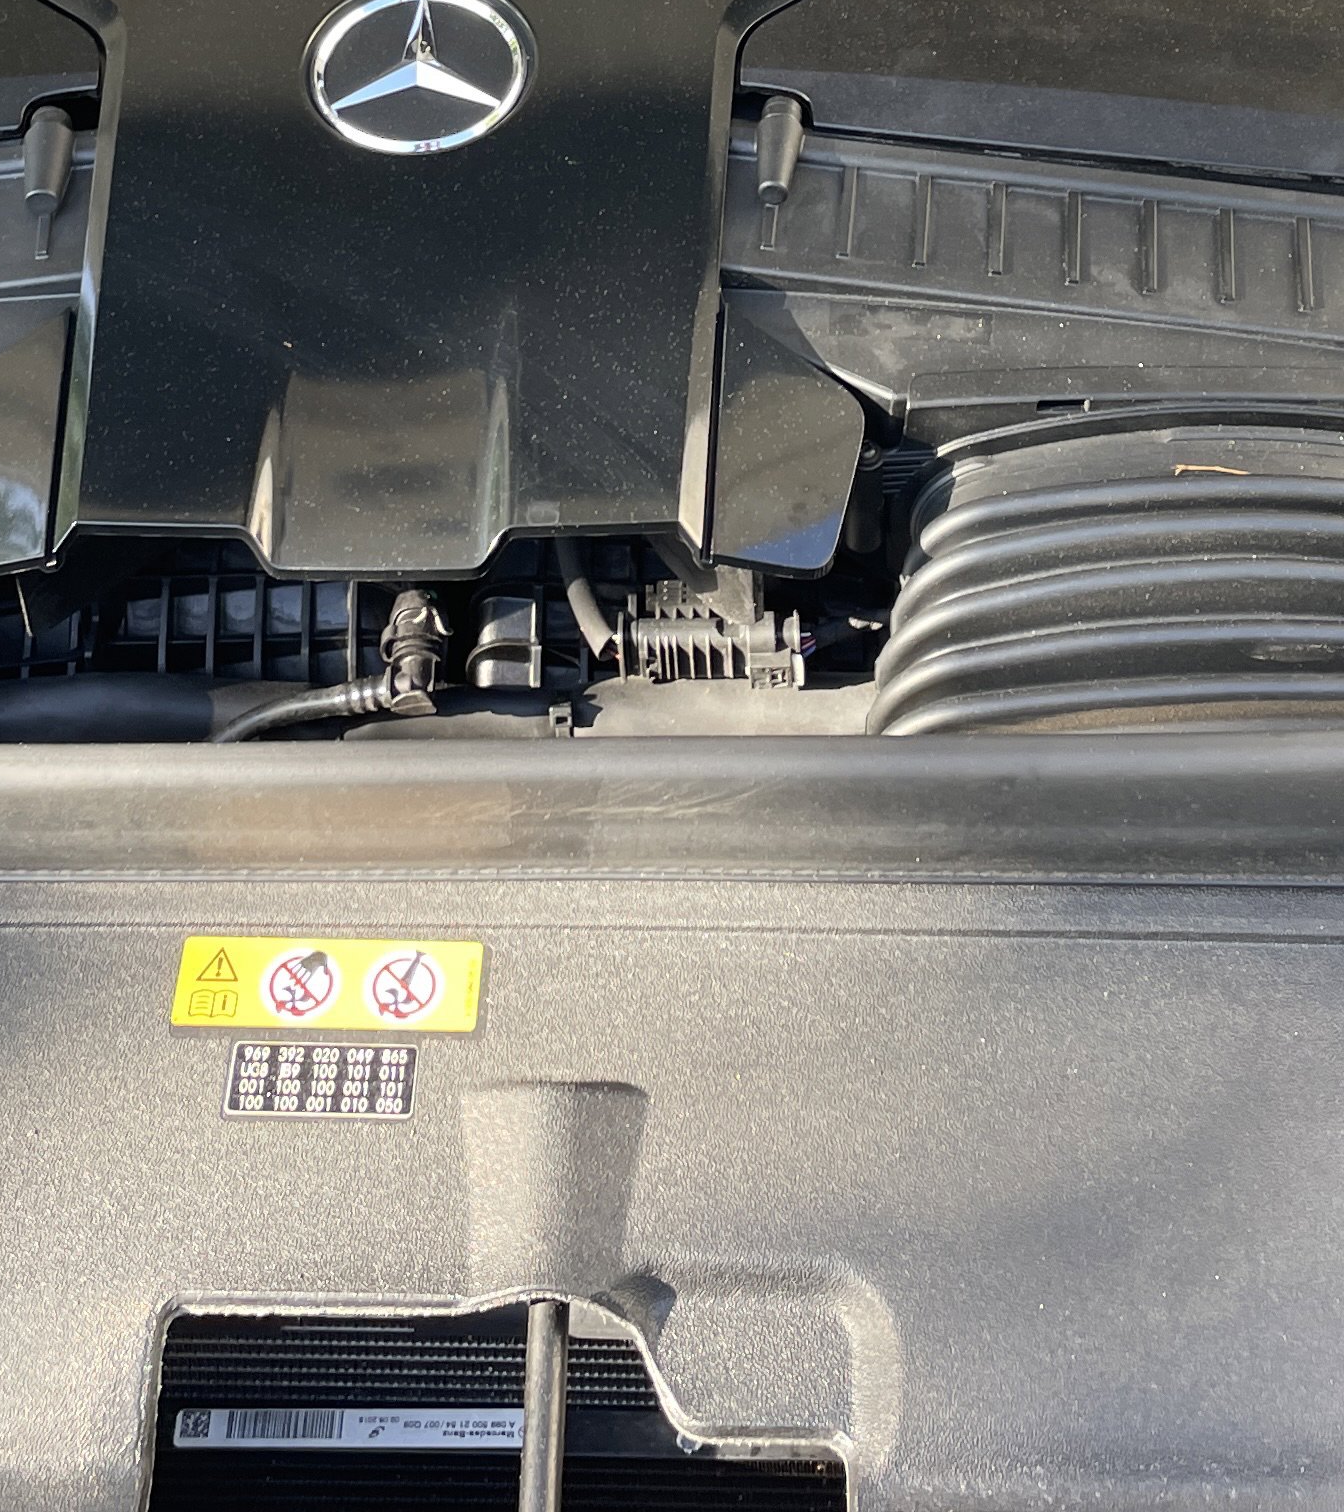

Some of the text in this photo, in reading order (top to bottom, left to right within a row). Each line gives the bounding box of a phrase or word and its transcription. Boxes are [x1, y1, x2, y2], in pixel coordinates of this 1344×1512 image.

[244, 1046, 271, 1062] 969
[278, 1046, 305, 1062] 392
[312, 1047, 340, 1063] 020
[346, 1048, 375, 1064] 049
[313, 1064, 338, 1080] 100
[347, 1064, 371, 1080] 101
[379, 1065, 405, 1081] 011
[238, 1078, 403, 1097] 001 100 100 001 101
[238, 1094, 403, 1114] 100 100 001 010 050
[442, 1430, 515, 1438] Mercedes-Benz
